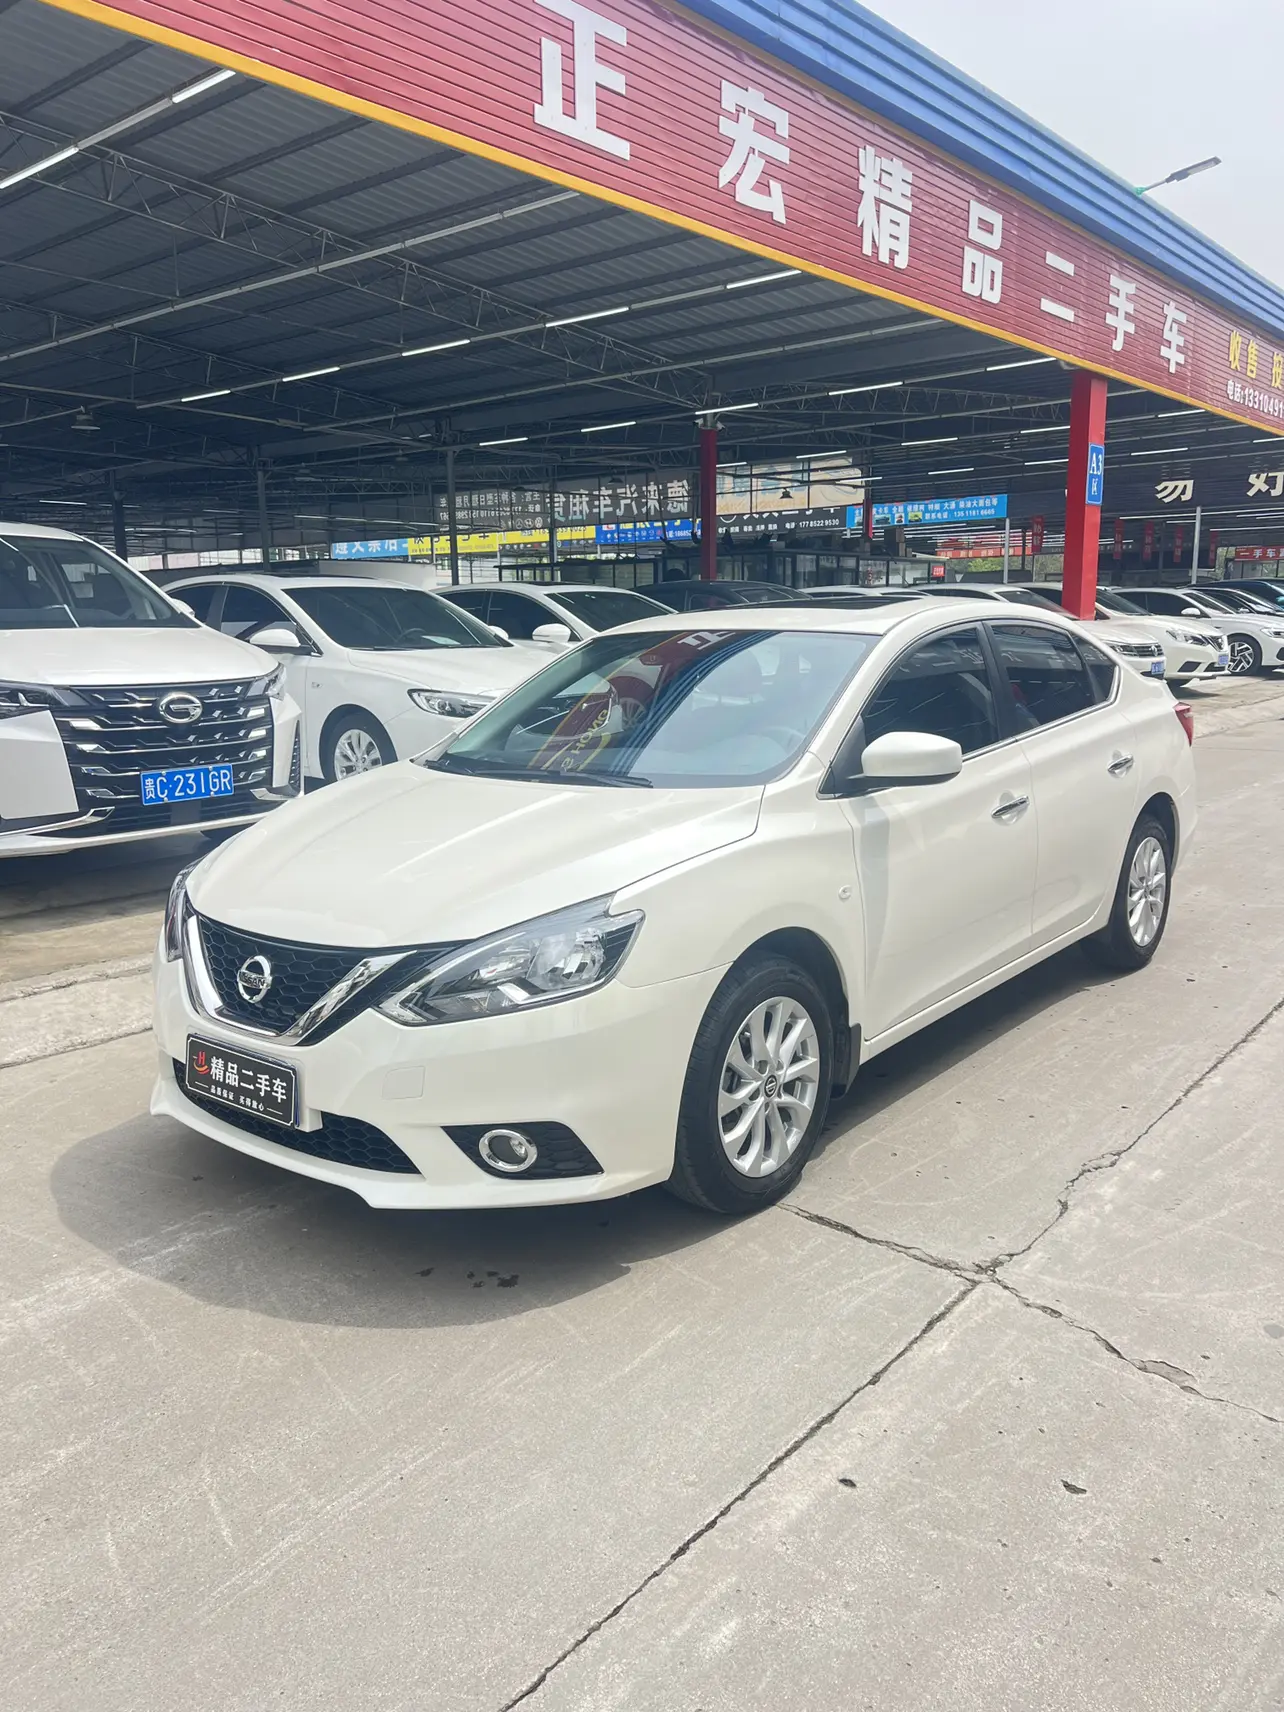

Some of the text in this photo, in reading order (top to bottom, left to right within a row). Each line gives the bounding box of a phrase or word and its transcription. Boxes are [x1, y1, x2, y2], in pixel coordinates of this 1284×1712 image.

[533, 0, 1187, 374] 正宏精品二手车
[1229, 330, 1258, 379] 收售
[1090, 452, 1103, 475] A3
[210, 1056, 287, 1103] 精品二手车
